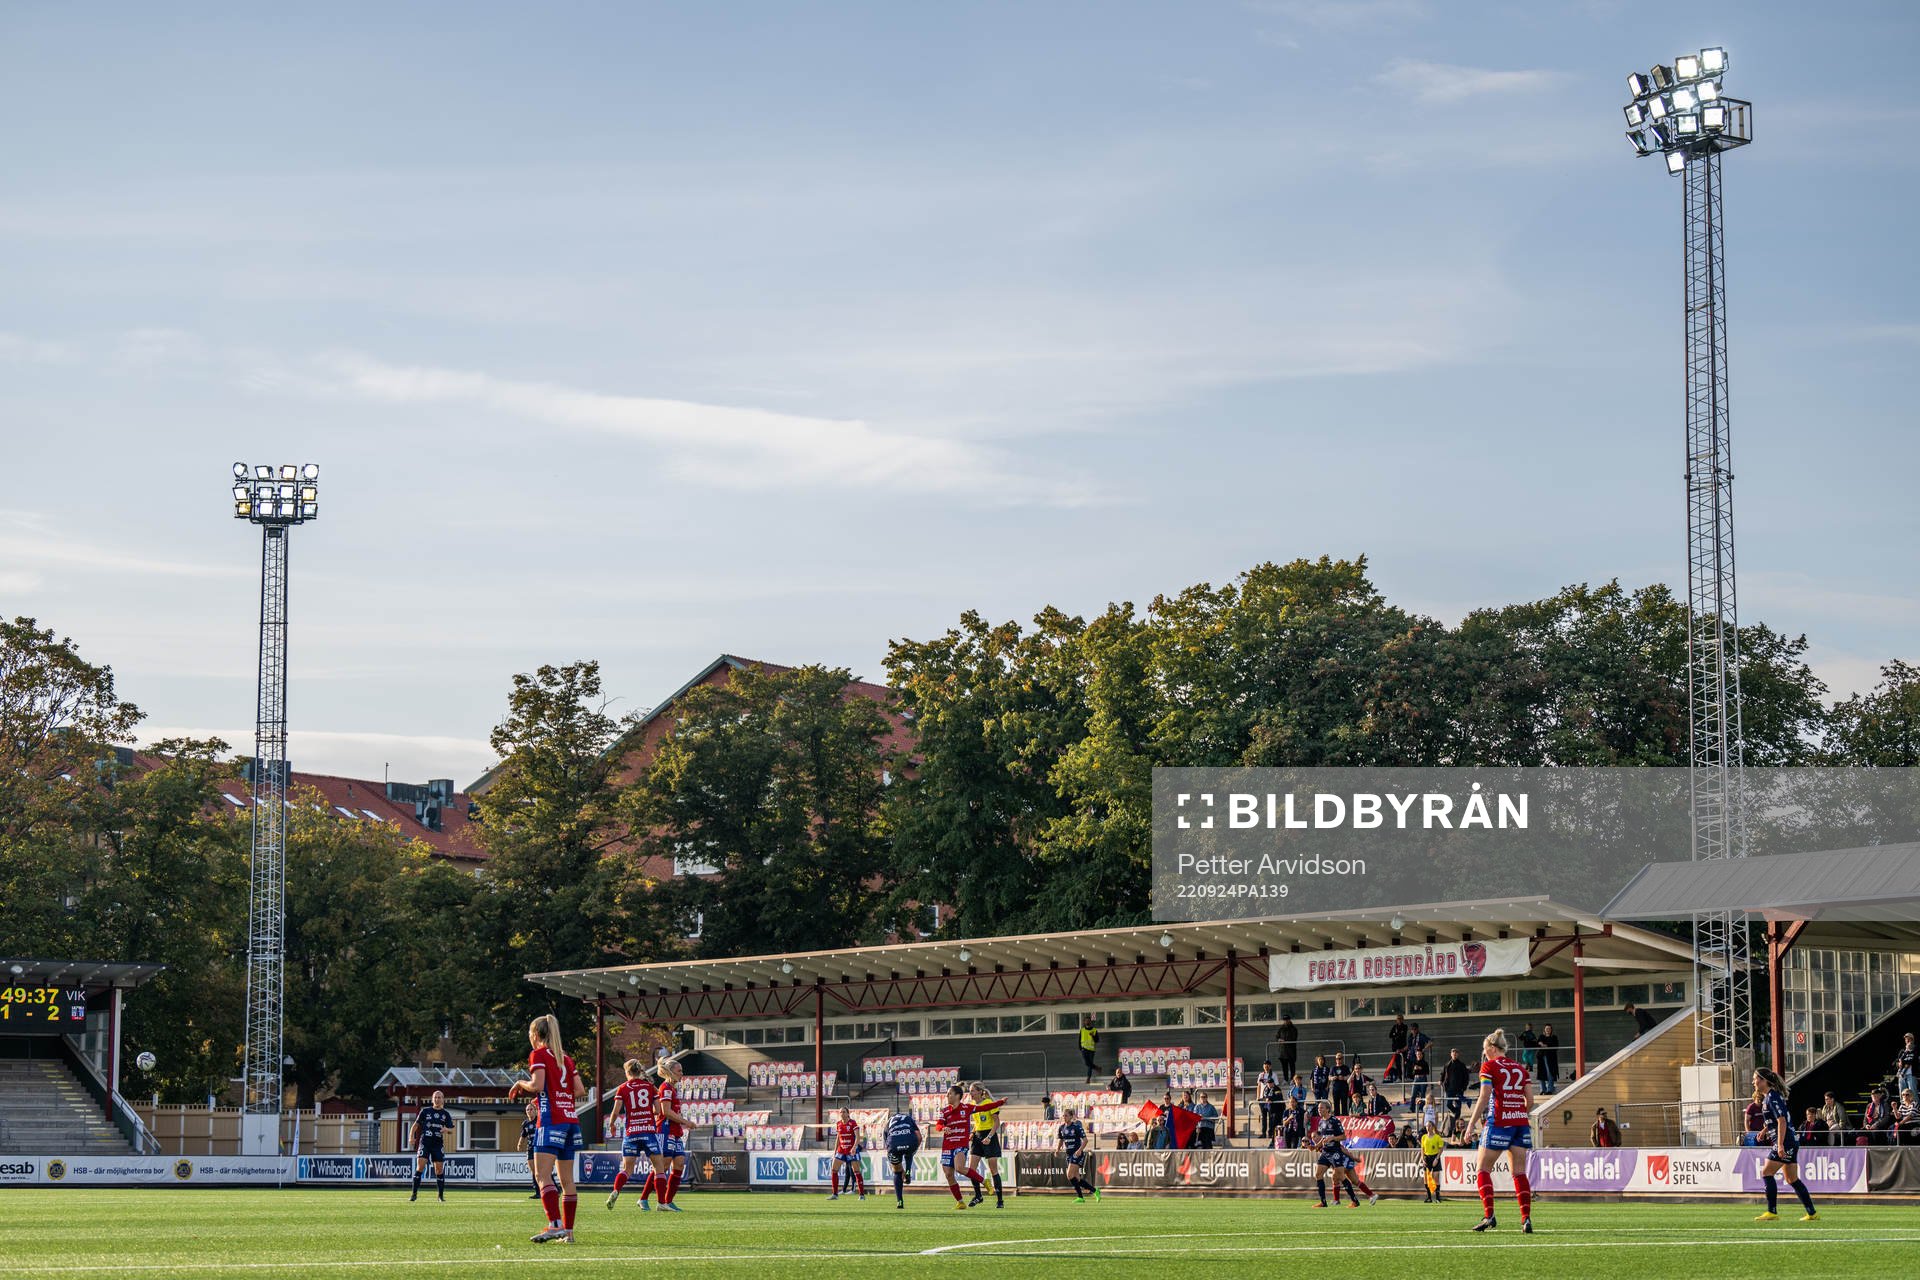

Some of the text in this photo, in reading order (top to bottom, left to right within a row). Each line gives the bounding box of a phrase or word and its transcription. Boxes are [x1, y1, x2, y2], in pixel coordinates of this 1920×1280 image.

[1308, 946, 1457, 982] FORZA ROSENGÅRD
[0, 987, 59, 1004] 49:37
[66, 990, 86, 1001] VIK
[47, 1005, 60, 1021] 2
[1499, 1068, 1523, 1090] 22
[629, 1088, 650, 1109] 18
[316, 1159, 352, 1178] Wihlborgs
[711, 1156, 737, 1165] CORPLUS
[759, 1160, 785, 1176] MKB
[1466, 1162, 1510, 1173] SVSKA
[1673, 1161, 1721, 1172] SVENSKA
[1805, 1156, 1847, 1181] alla!
[106, 1167, 153, 1176] möjligheterna
[231, 1167, 276, 1176] möjligheterna
[374, 1160, 411, 1178] Wihlborgs
[443, 1160, 475, 1178] ihlborgs
[1021, 1165, 1042, 1175] MALMÖ
[1043, 1167, 1064, 1175] ARENA
[1540, 1156, 1620, 1185] Heja alla!
[1673, 1174, 1698, 1185] SPEL
